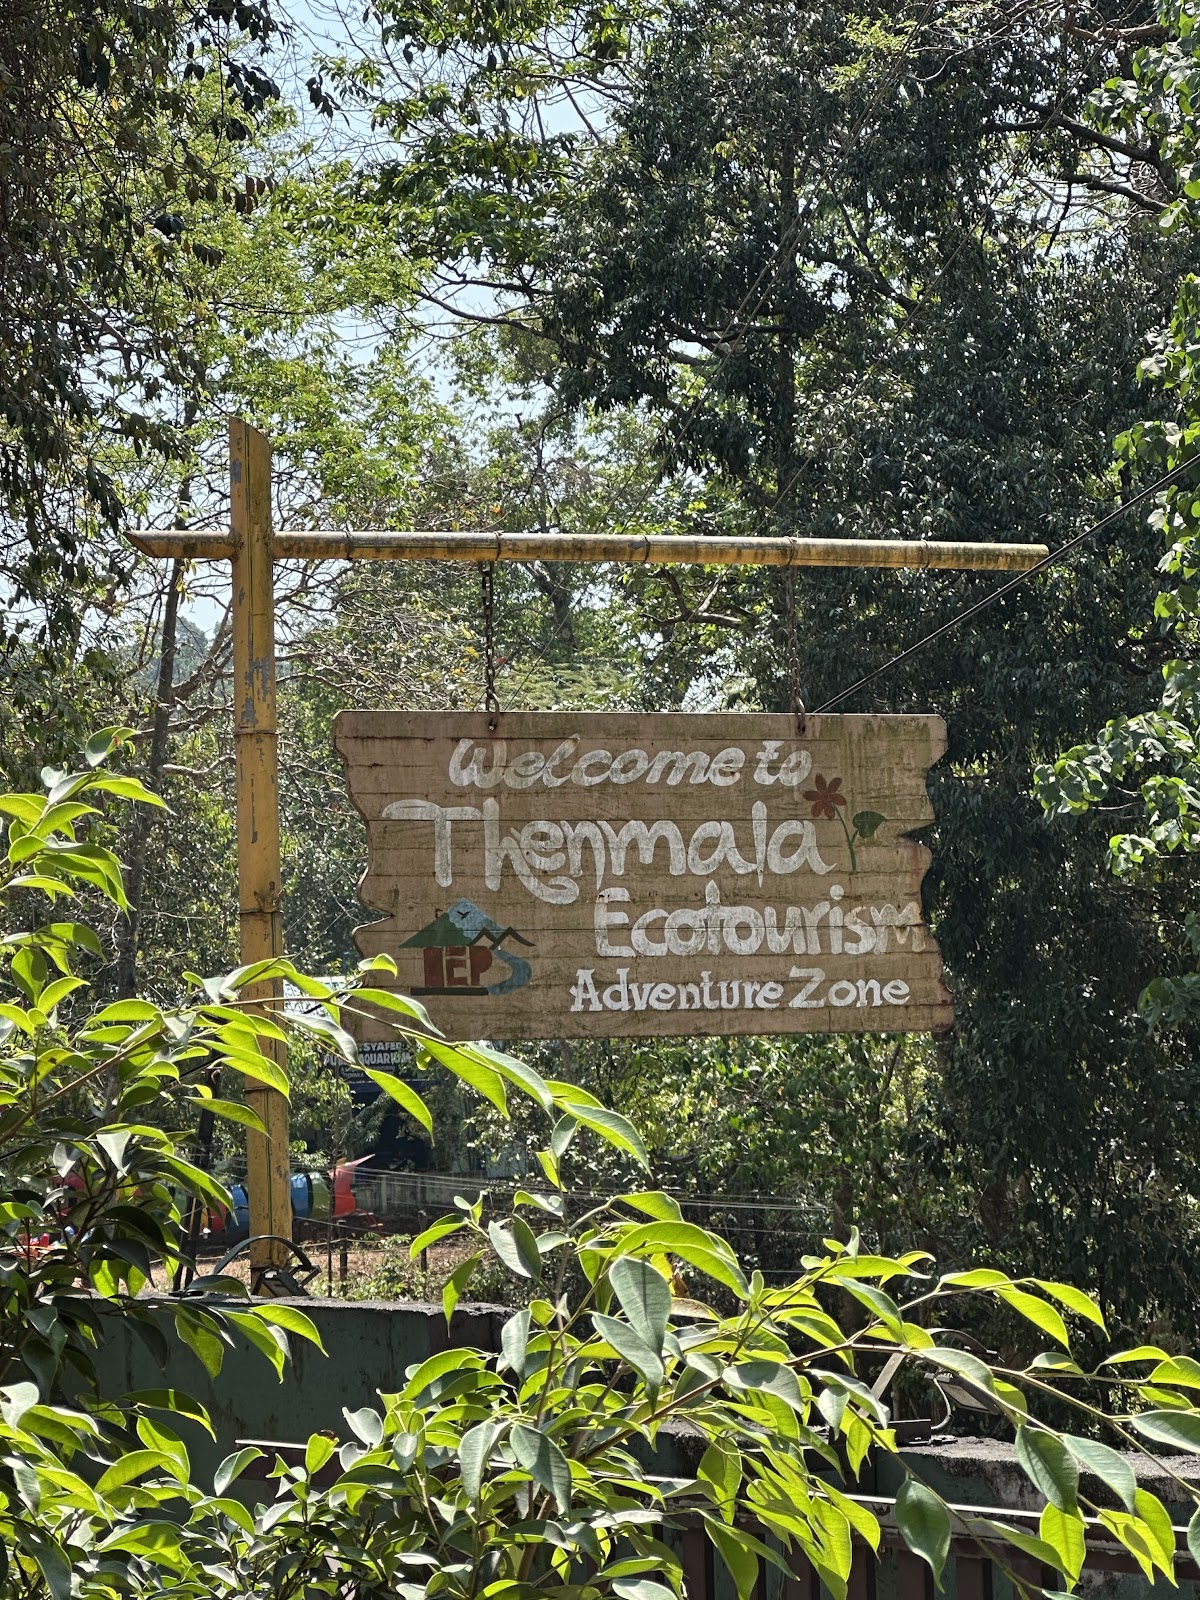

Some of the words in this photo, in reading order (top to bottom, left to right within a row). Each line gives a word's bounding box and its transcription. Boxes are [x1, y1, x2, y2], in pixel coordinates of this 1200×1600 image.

[449, 734, 745, 788] Welcome
[753, 741, 812, 787] to
[381, 797, 838, 904] Thenmala
[594, 879, 926, 957] Ecotourism
[569, 967, 784, 1012] Adventure
[789, 965, 911, 1009] Zone
[359, 1041, 403, 1052] SYAFED
